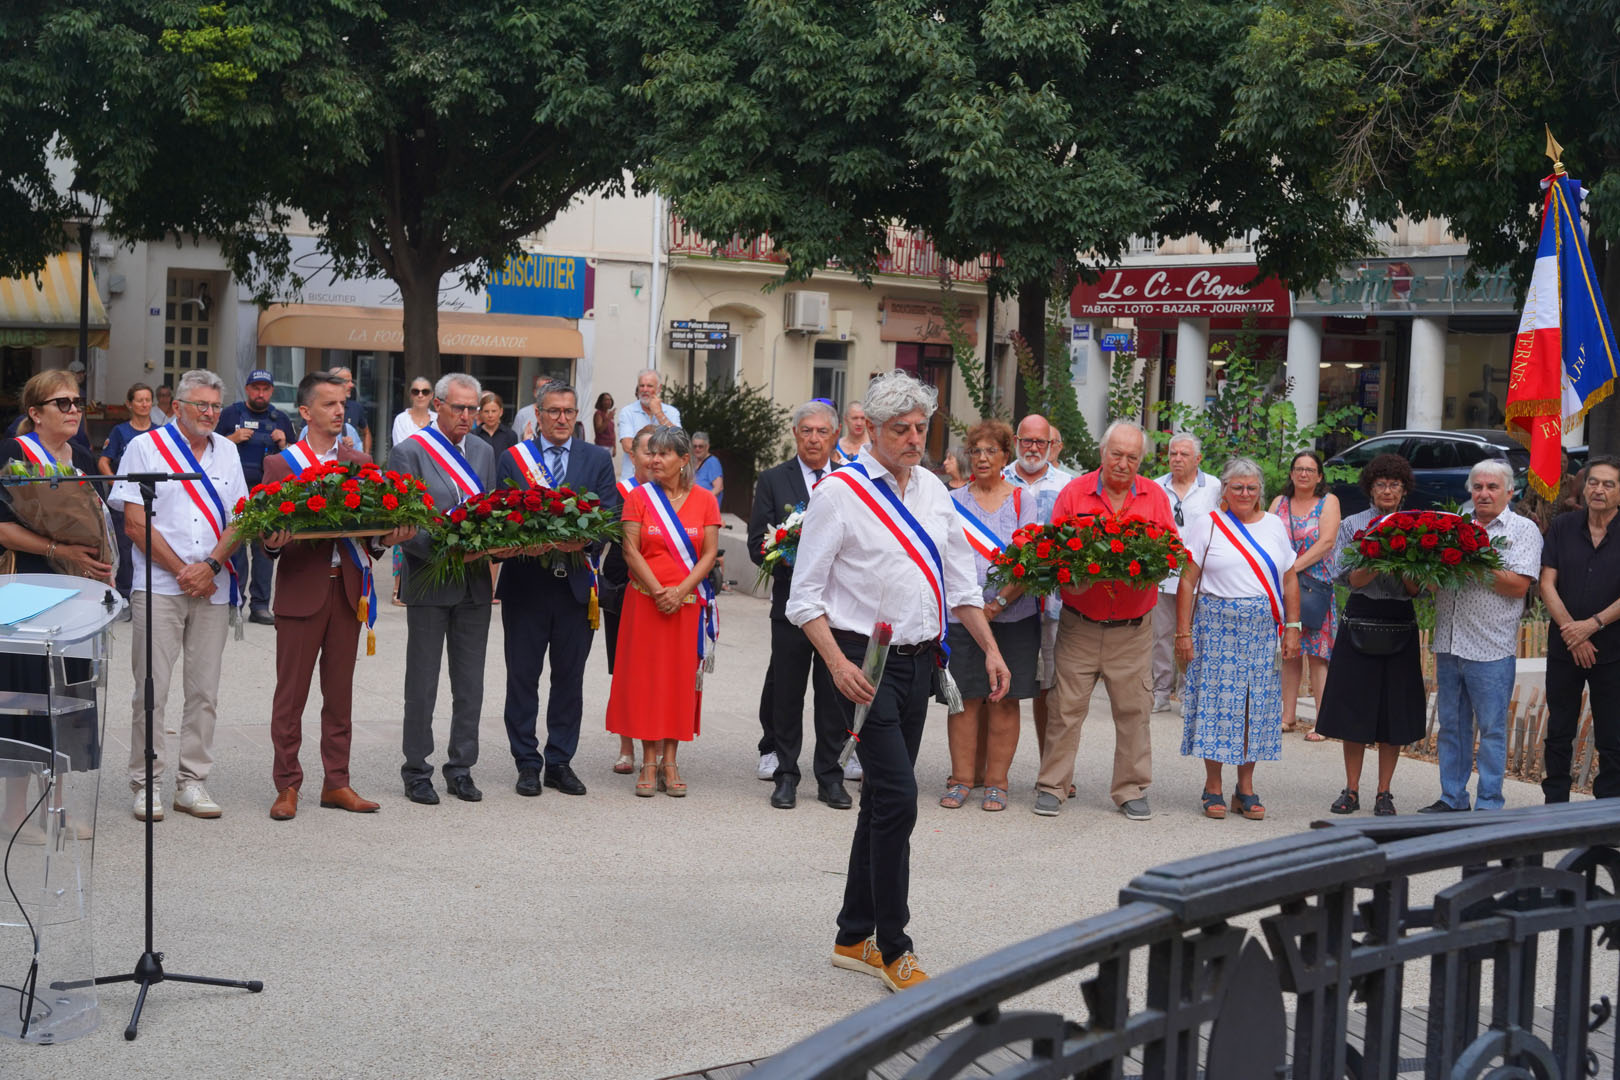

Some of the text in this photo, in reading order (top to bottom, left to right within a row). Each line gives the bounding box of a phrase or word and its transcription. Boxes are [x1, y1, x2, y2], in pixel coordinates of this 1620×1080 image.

[502, 253, 575, 290] BISCUITIER
[1098, 271, 1138, 299] Le
[308, 291, 356, 304] BISCUITIER
[1081, 304, 1116, 314] TABAC
[1124, 304, 1154, 314] LOTO
[1162, 303, 1200, 314] BAZAR
[1209, 302, 1275, 313] JOURNAUX
[688, 321, 728, 330] Police Municipale
[348, 329, 528, 349] LA FOU GOURMANDE
[686, 331, 694, 339] de
[672, 341, 687, 349] Office
[687, 341, 694, 349] de
[1509, 310, 1537, 391] INTERNÉS
